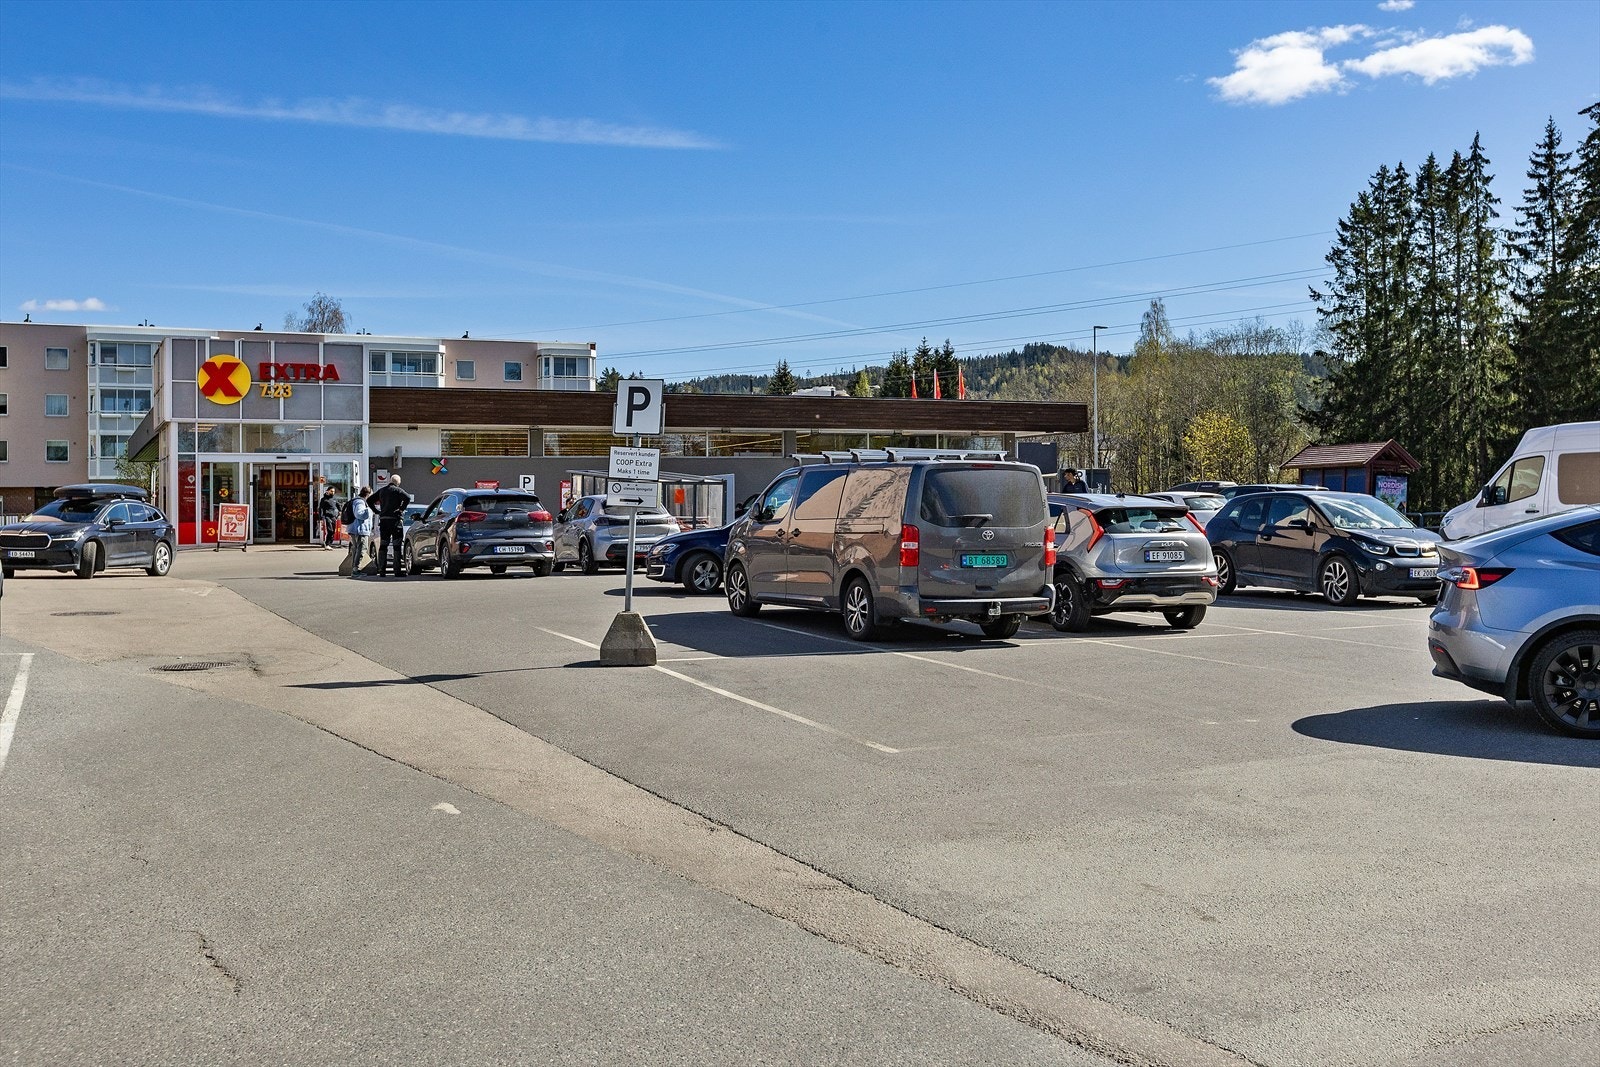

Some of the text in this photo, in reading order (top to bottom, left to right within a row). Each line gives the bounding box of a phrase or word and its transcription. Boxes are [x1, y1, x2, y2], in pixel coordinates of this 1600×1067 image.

[259, 362, 339, 381] EXTRA
[626, 386, 651, 427] P
[523, 476, 531, 488] P
[225, 522, 237, 533] 12
[968, 556, 1006, 566] BT 68589
[1152, 551, 1183, 560] EF 91085
